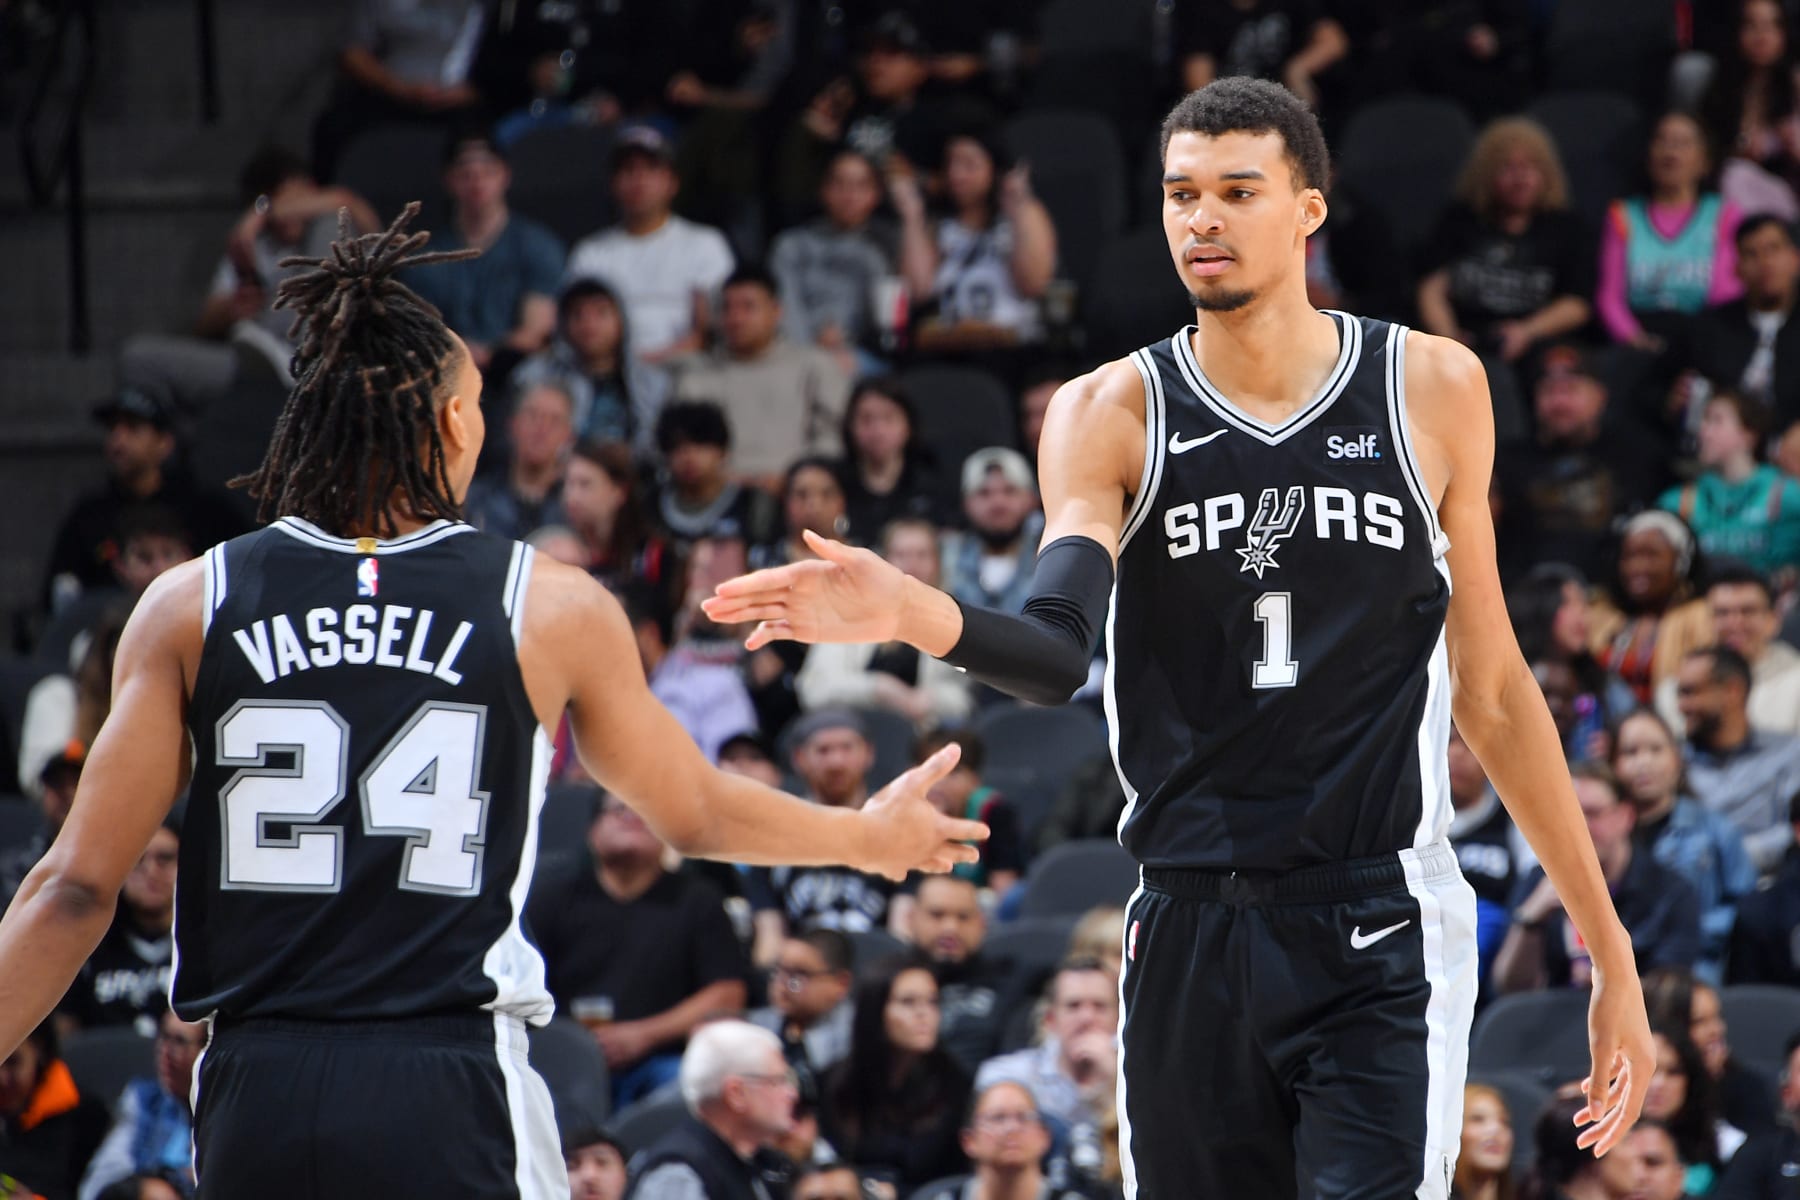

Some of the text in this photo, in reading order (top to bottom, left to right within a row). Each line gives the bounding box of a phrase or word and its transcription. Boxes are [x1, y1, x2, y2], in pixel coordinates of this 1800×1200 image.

[1164, 485, 1405, 580] SPURS
[232, 604, 473, 686] VASSELL
[1252, 591, 1299, 689] 1
[215, 698, 491, 897] 24
